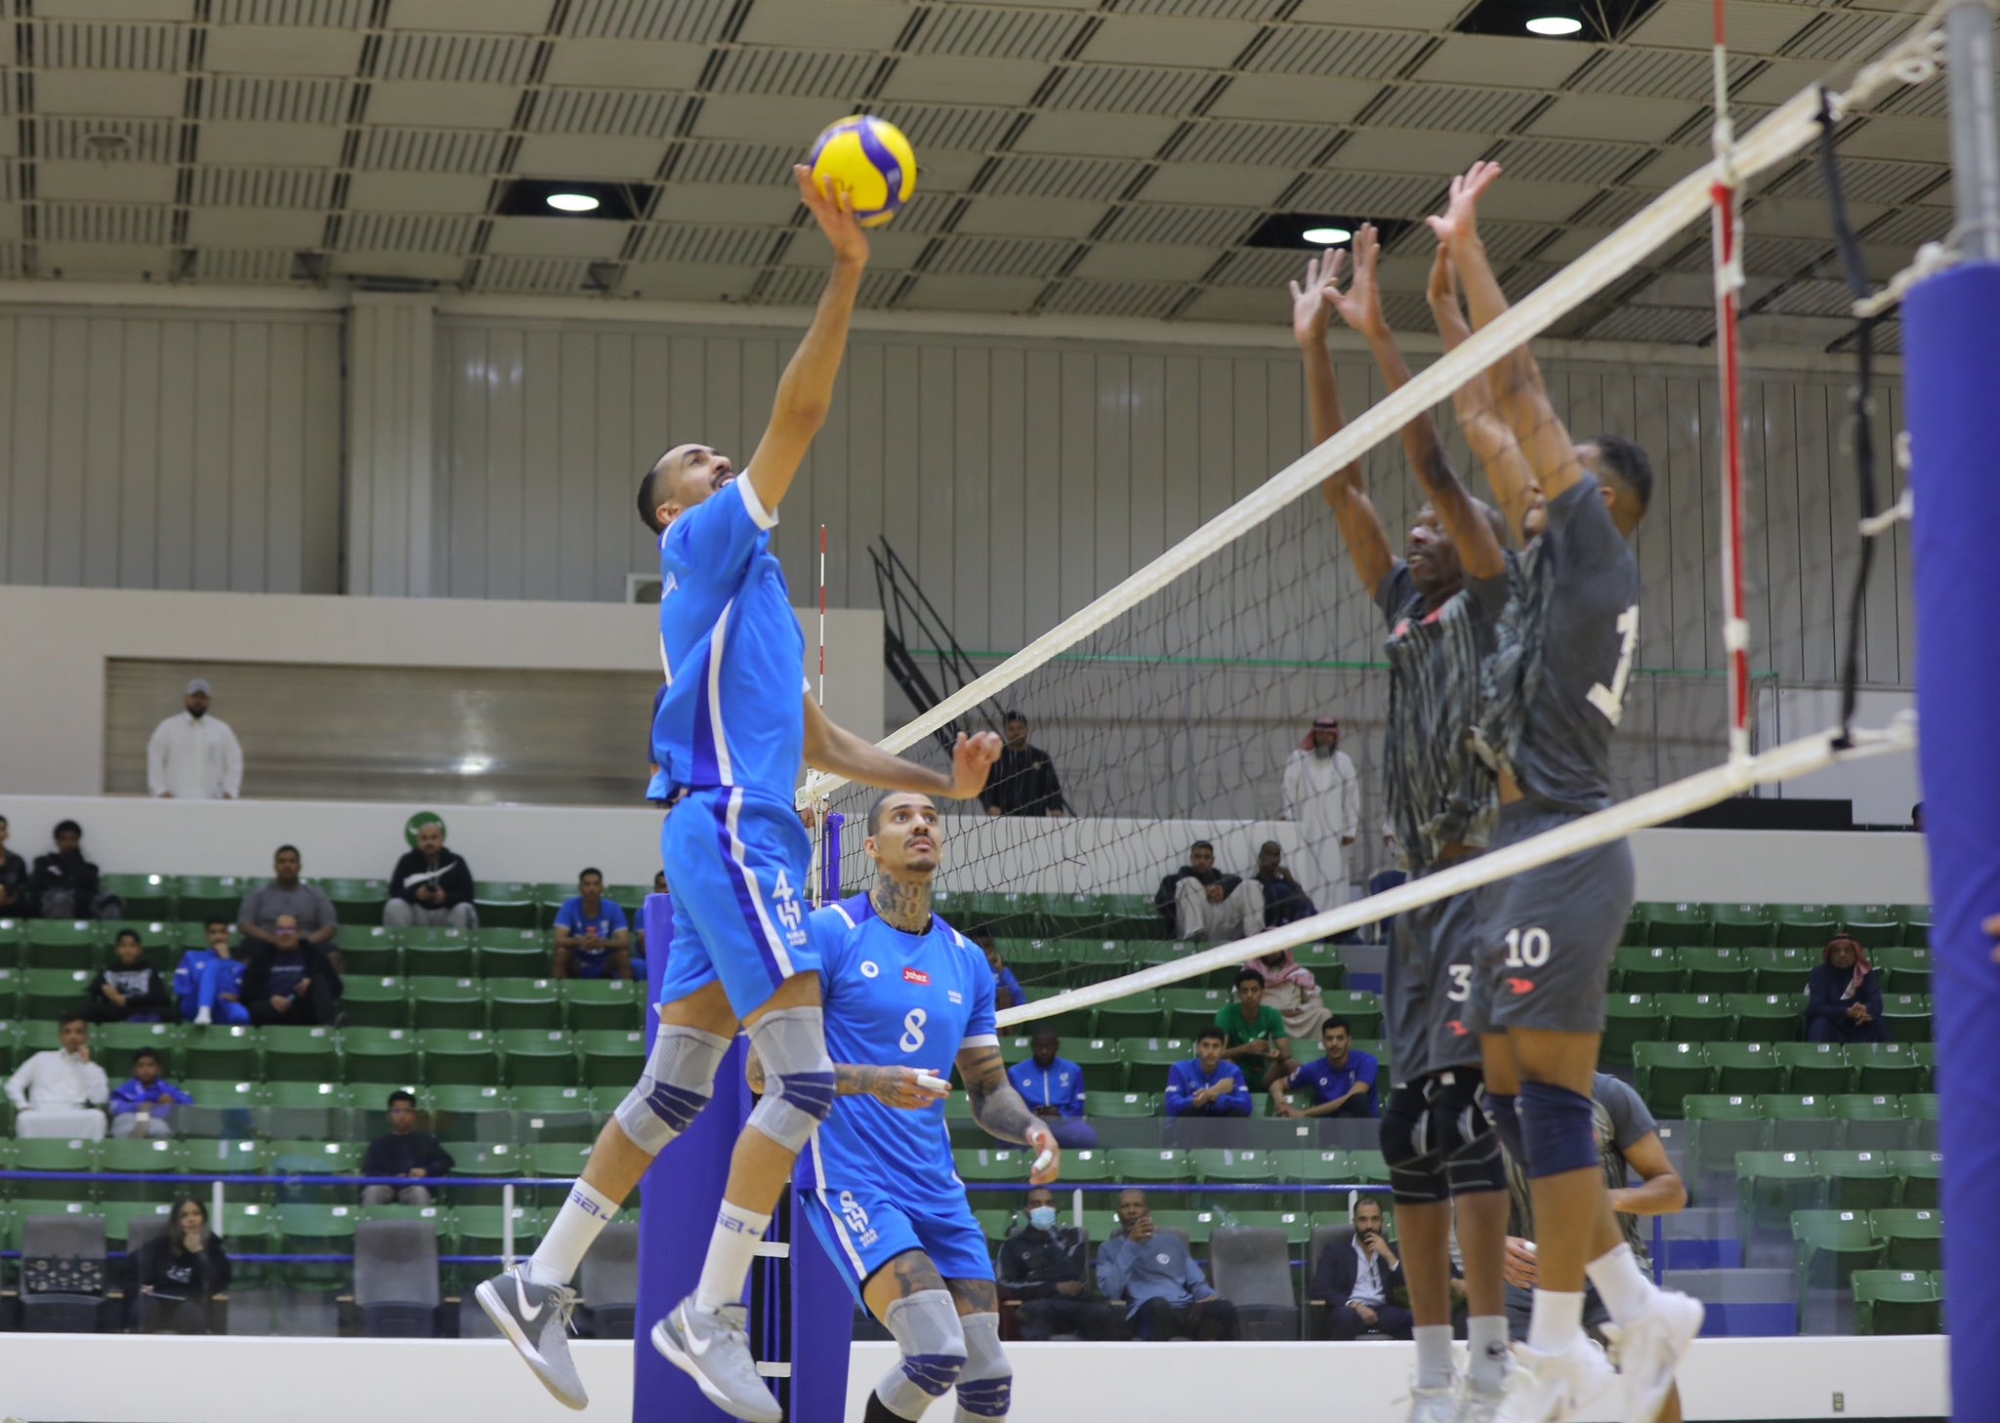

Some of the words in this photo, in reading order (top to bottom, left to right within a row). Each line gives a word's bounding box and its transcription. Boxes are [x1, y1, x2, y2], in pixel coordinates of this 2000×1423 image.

[771, 868, 795, 901] 4
[1505, 927, 1551, 968] 10
[1447, 964, 1473, 1002] 3
[899, 1007, 927, 1053] 8
